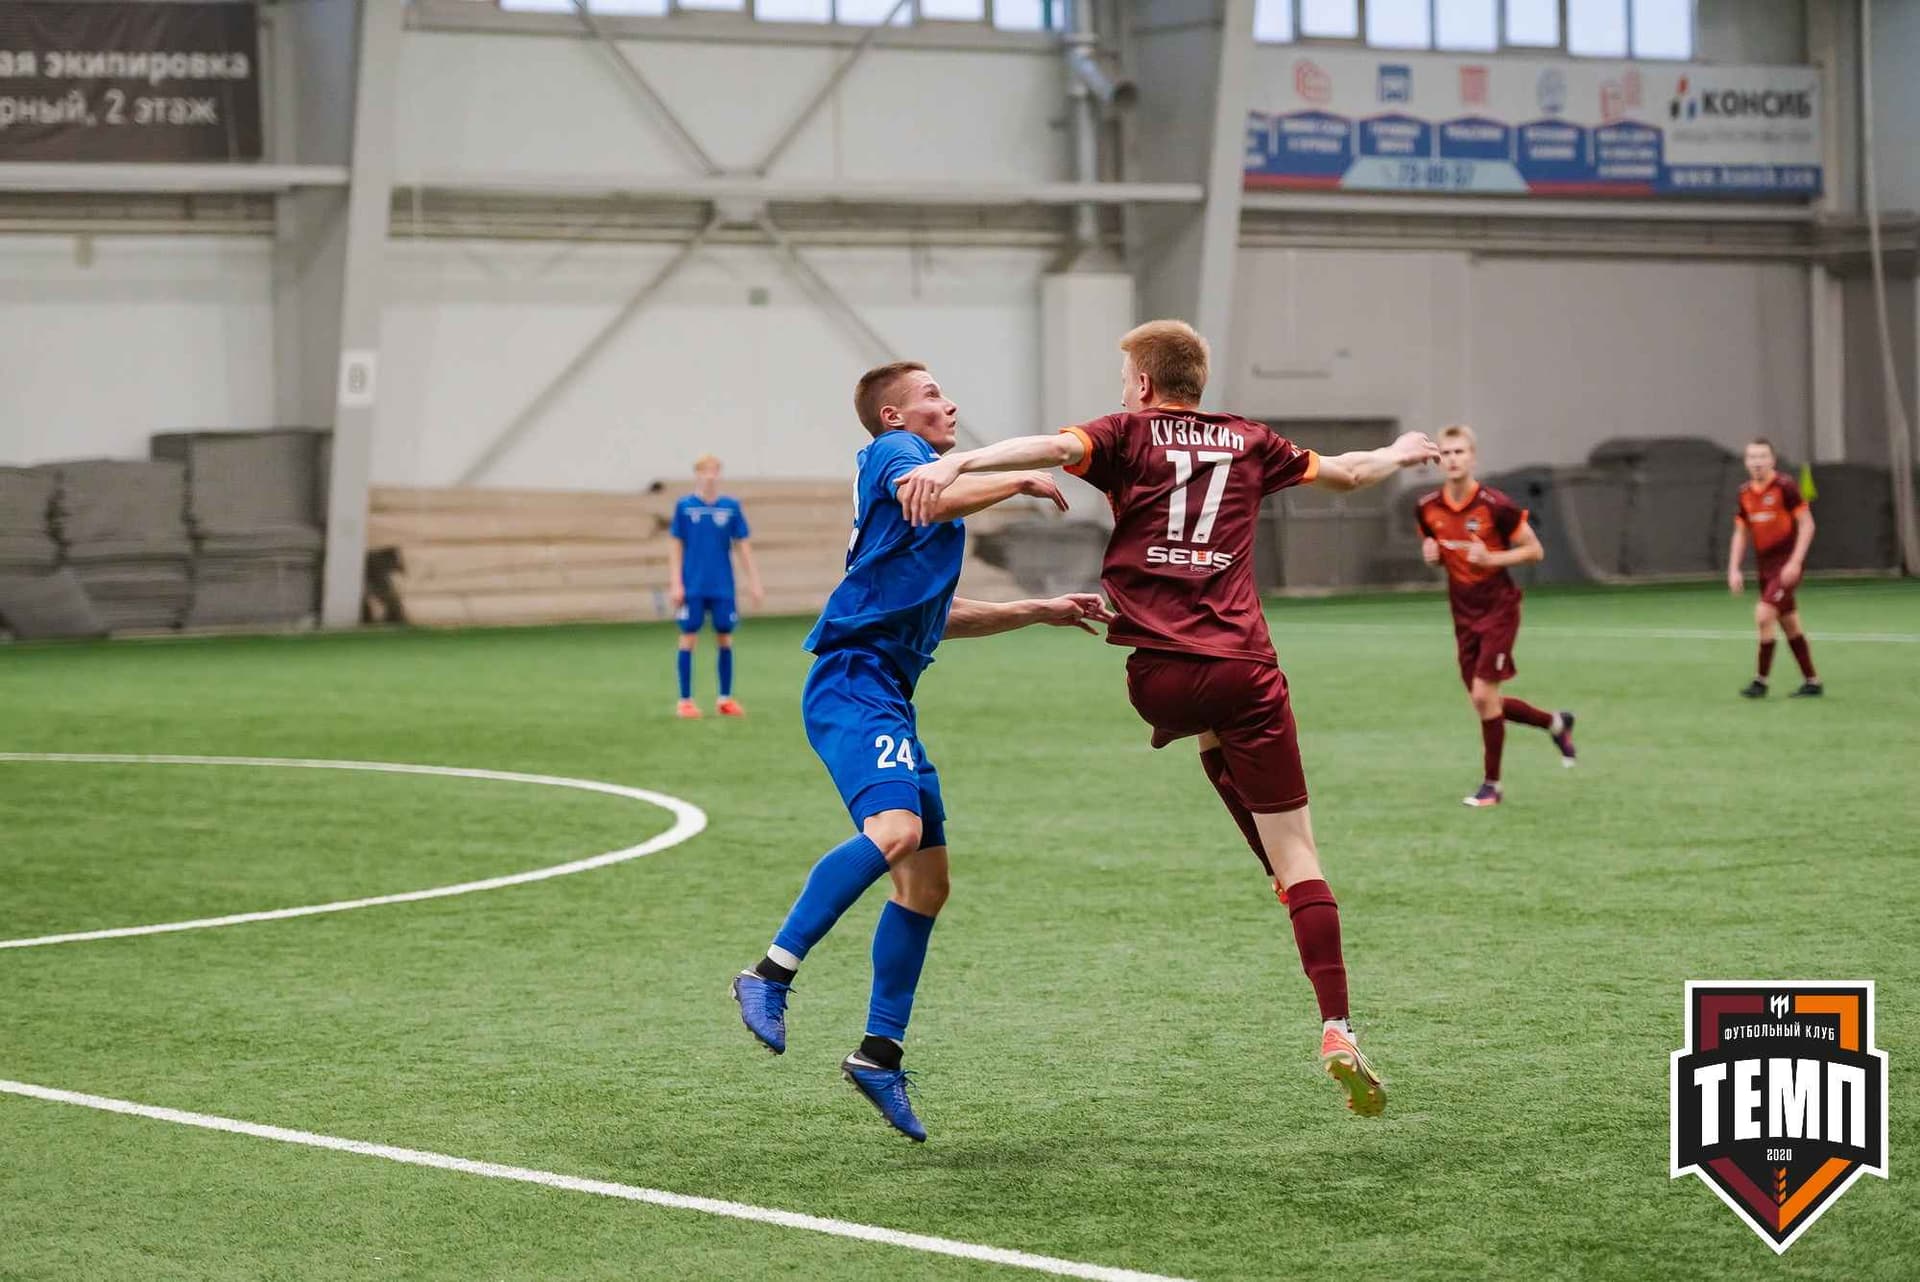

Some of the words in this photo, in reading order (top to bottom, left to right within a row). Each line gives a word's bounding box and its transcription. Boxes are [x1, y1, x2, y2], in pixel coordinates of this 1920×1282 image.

[45, 52, 248, 85] экипировка
[104, 88, 126, 124] 2
[134, 98, 217, 125] этаж
[1703, 88, 1812, 119] КОНСИБ
[1166, 450, 1233, 543] 17
[1146, 547, 1233, 570] SEUS
[875, 735, 914, 771] 24
